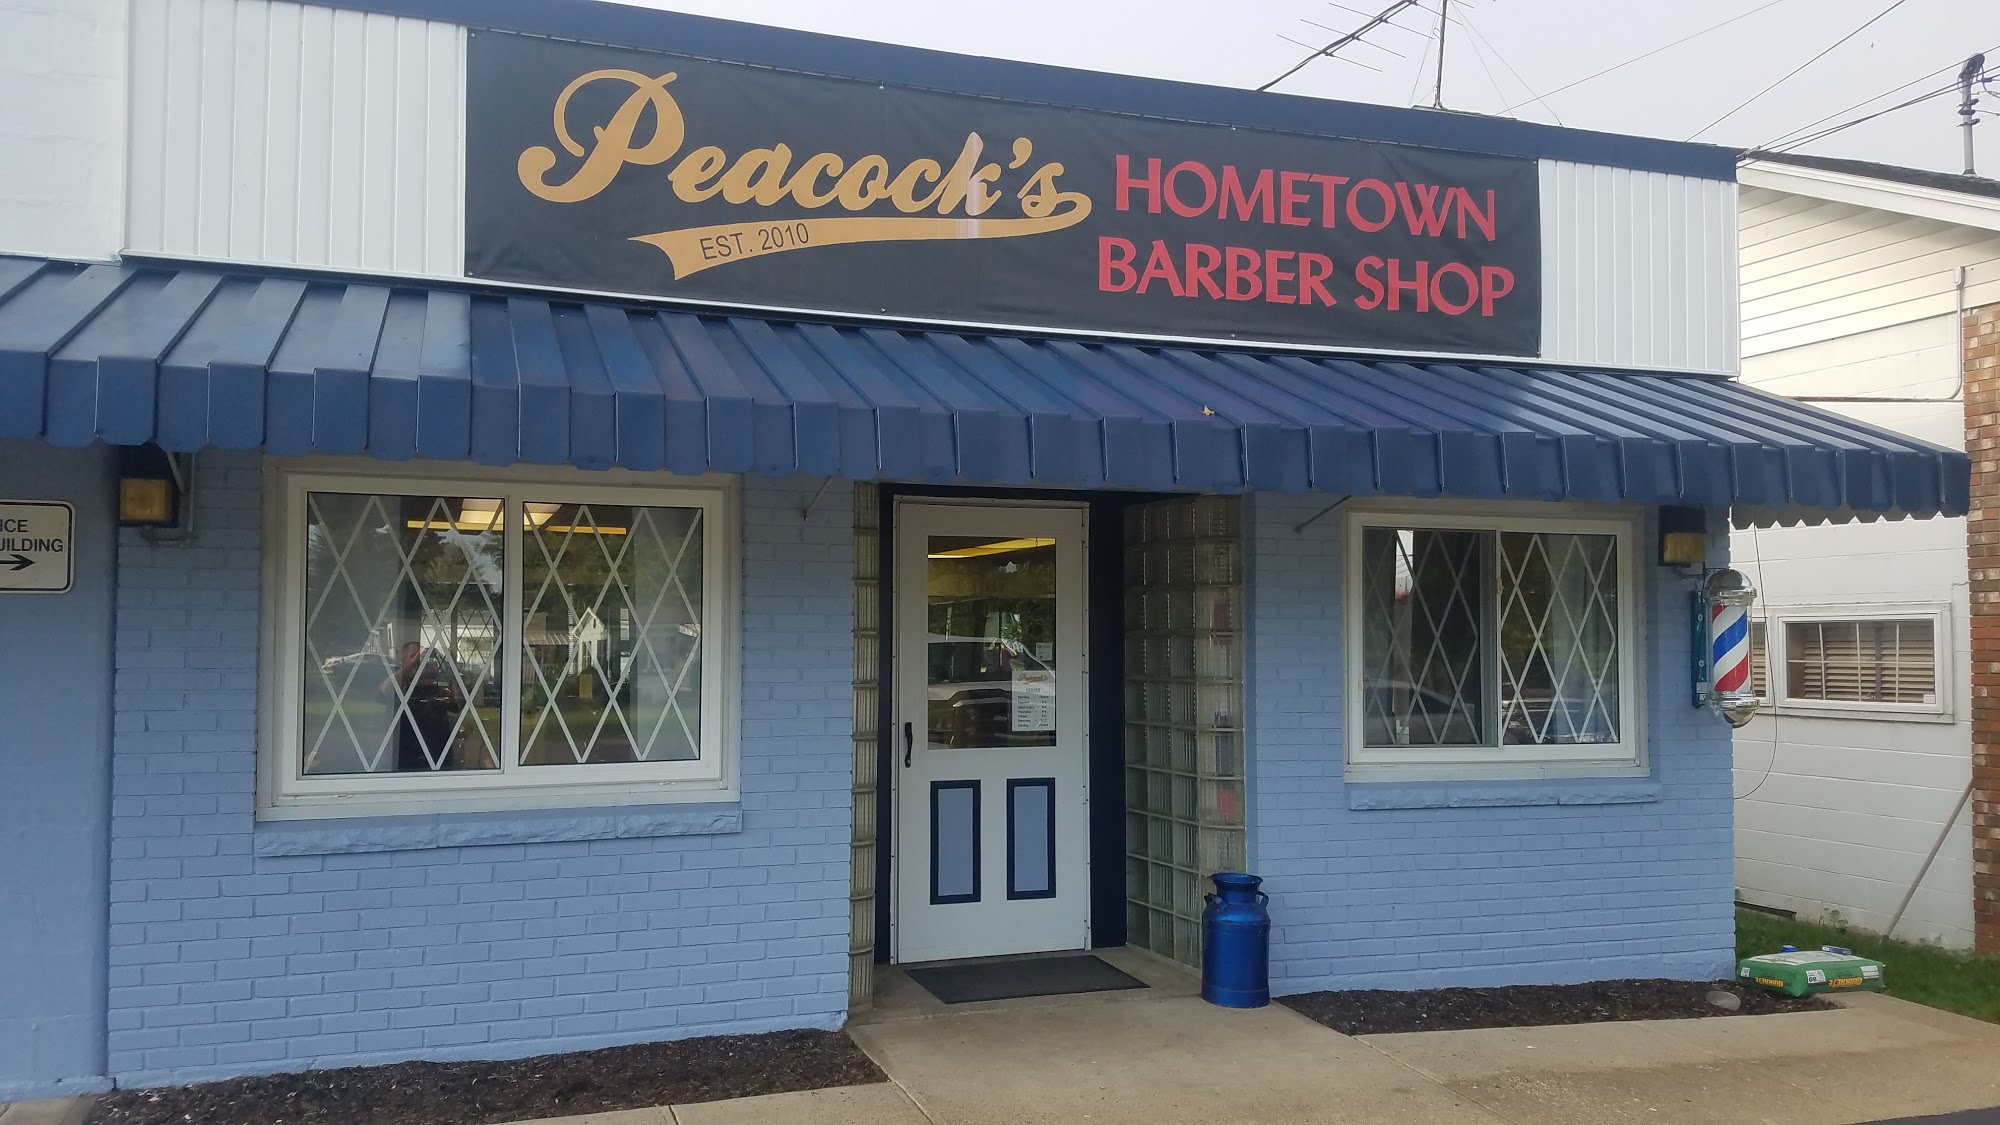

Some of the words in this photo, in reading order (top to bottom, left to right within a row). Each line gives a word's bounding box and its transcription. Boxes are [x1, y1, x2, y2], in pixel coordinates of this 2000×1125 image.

[518, 69, 1092, 218] Peacock's
[1115, 154, 1496, 241] HOMETOWN
[699, 232, 753, 260] EST.
[758, 222, 809, 251] 2010
[1098, 236, 1338, 307] BARBER
[1354, 256, 1516, 317] SHOP
